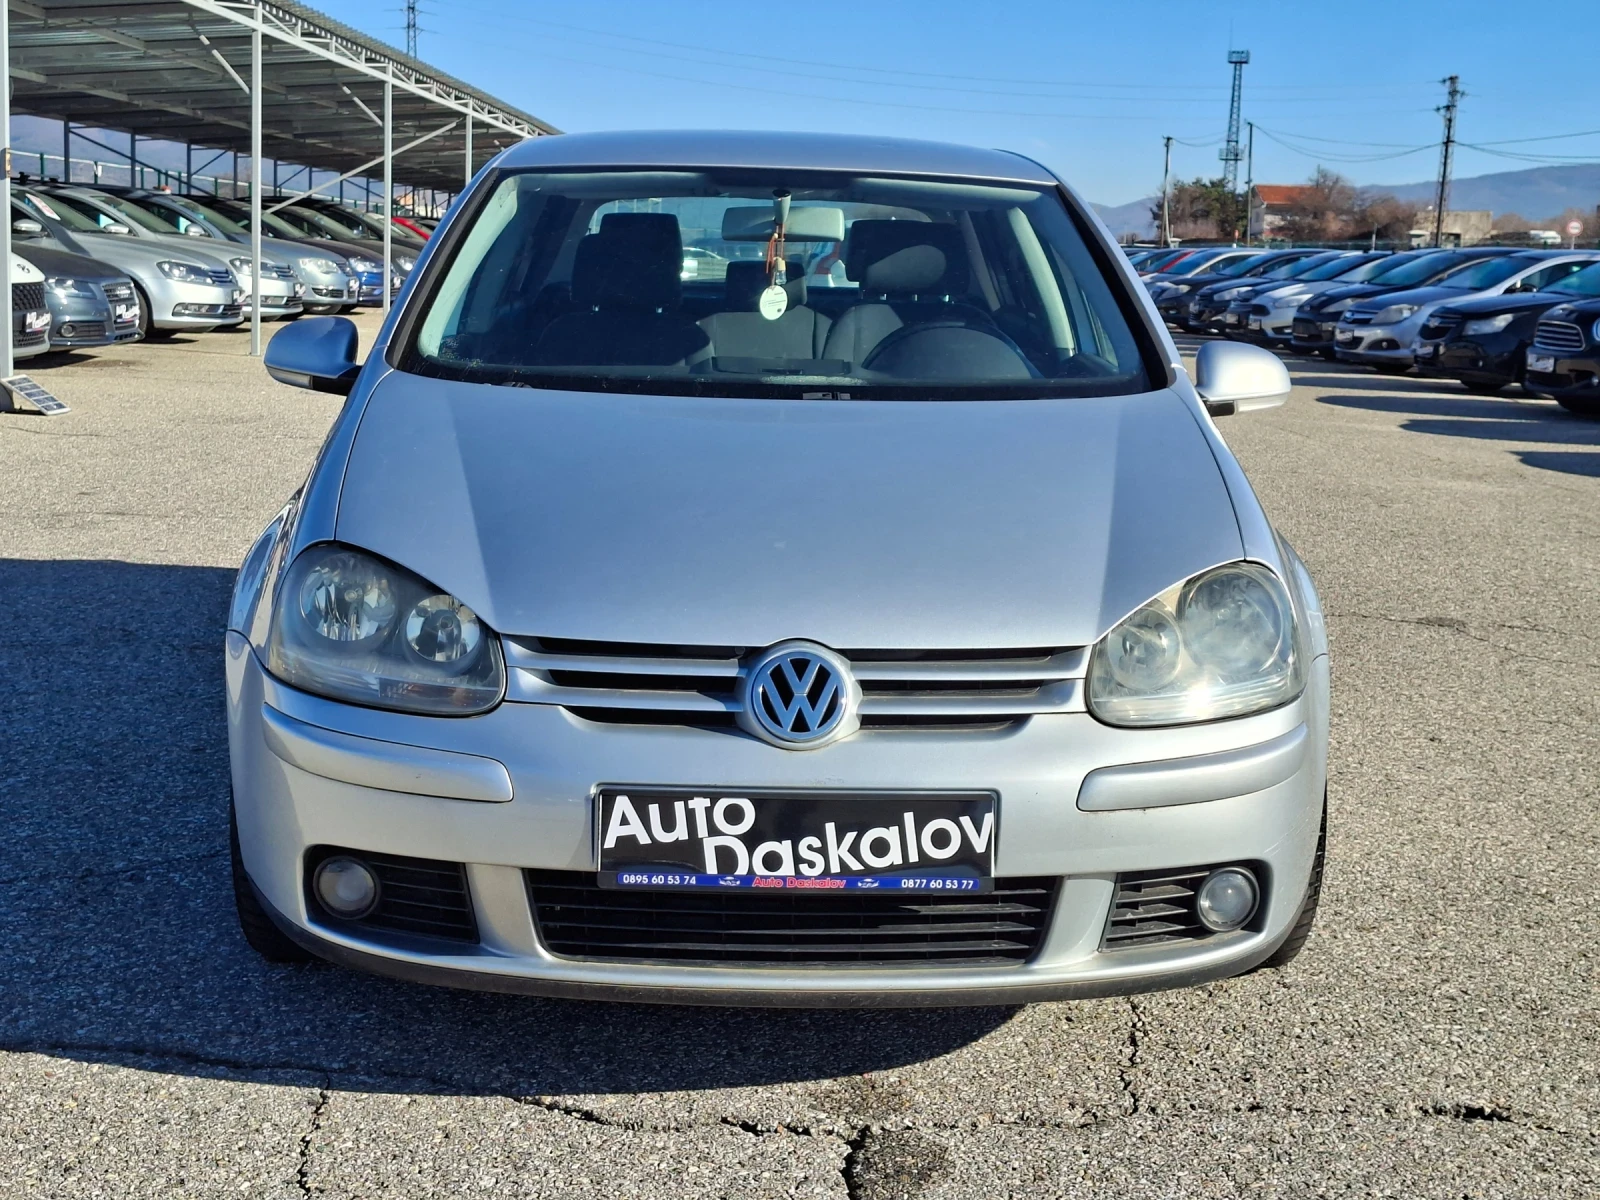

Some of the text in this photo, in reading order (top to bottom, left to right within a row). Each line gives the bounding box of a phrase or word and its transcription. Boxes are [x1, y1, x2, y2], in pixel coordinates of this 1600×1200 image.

[753, 651, 845, 740] VW
[604, 795, 756, 849] Auto
[702, 811, 994, 877] Daskalov
[622, 874, 697, 886] 0895 60 53 74
[751, 876, 847, 889] Auto Daskalov
[901, 878, 974, 890] 0877 60 53 77
